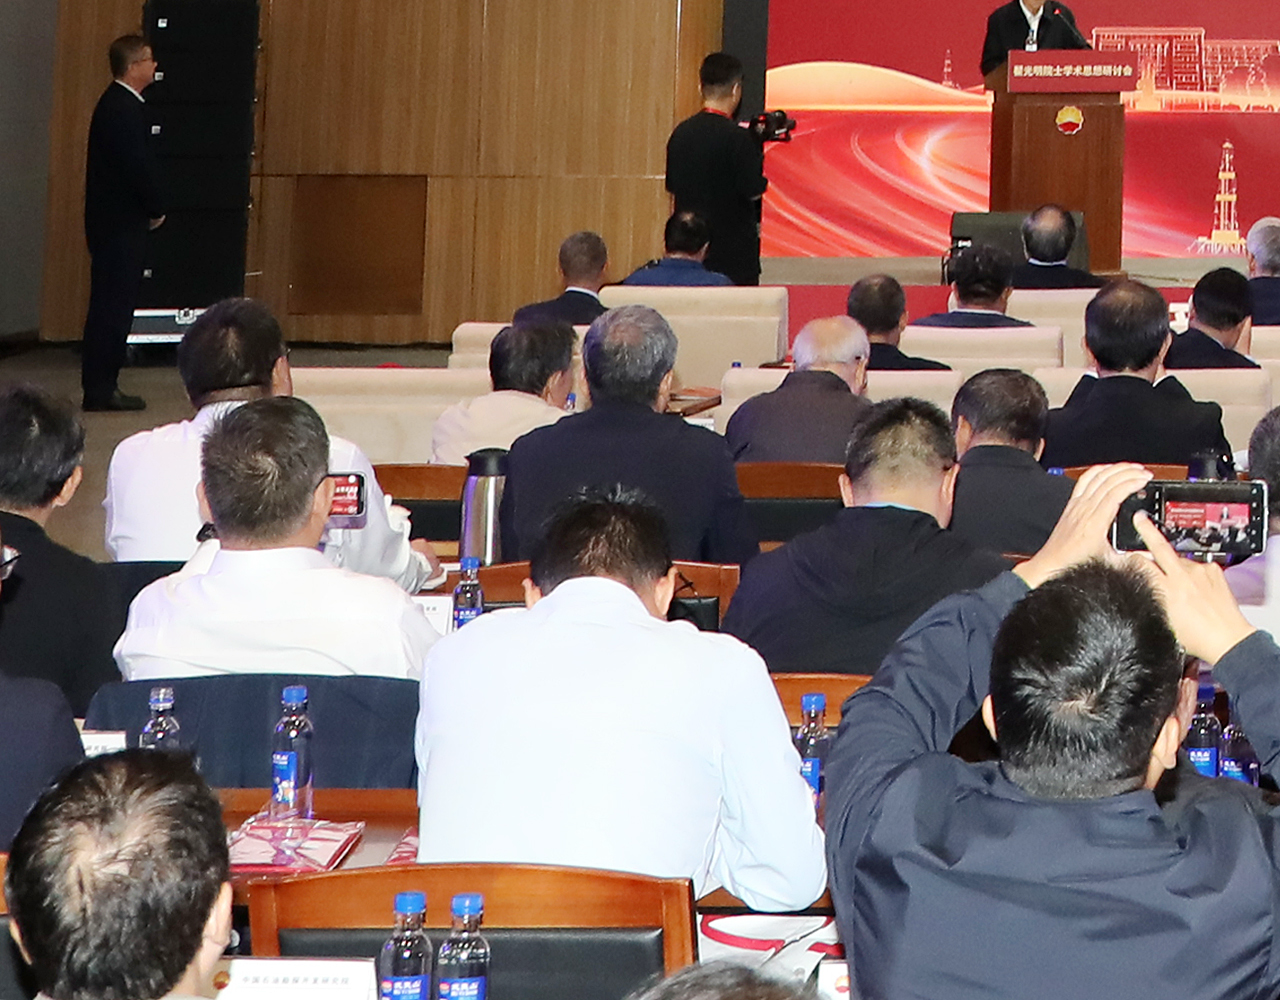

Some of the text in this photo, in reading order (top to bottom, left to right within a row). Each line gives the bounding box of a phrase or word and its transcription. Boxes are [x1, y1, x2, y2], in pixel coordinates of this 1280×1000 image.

[1013, 65, 1133, 77] 翟光明院士学术思想研讨会
